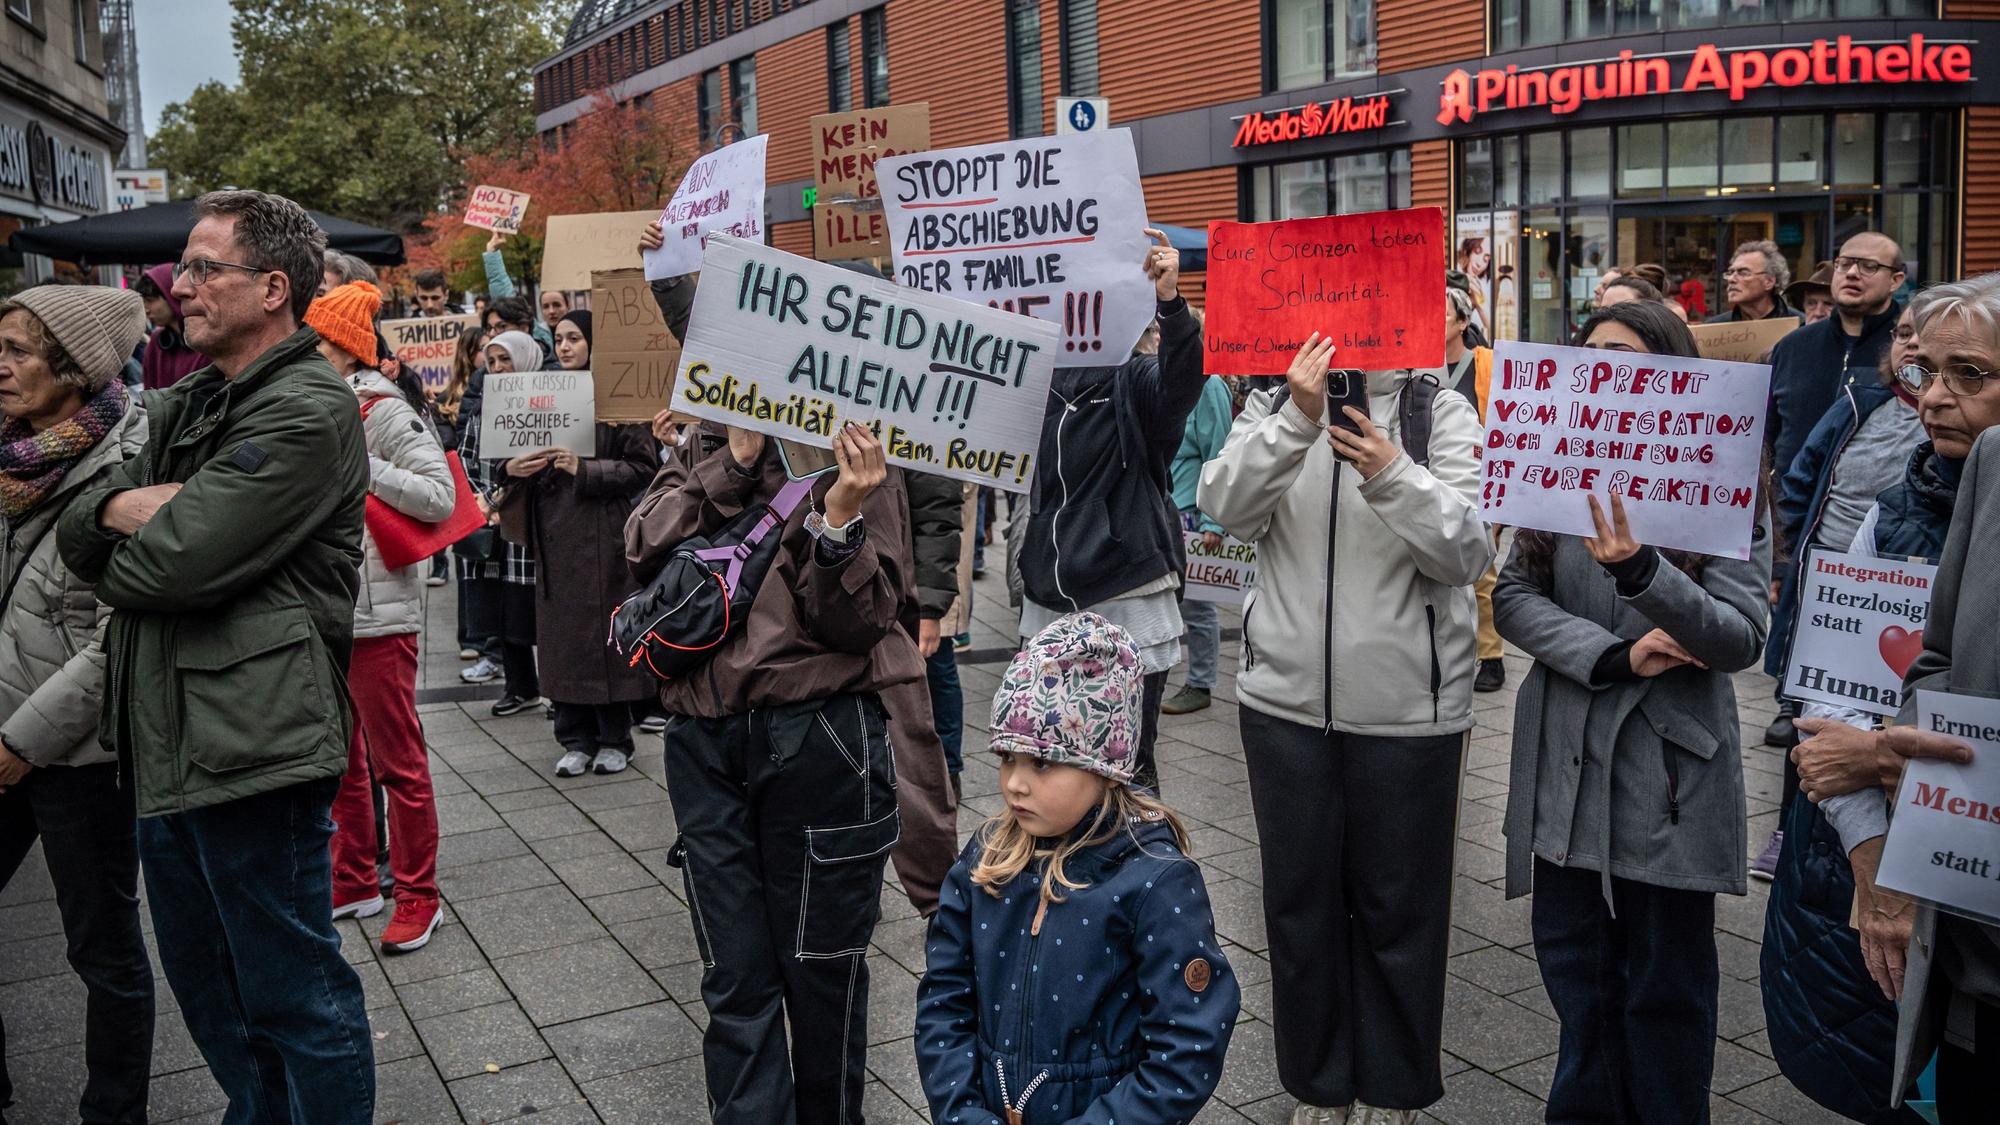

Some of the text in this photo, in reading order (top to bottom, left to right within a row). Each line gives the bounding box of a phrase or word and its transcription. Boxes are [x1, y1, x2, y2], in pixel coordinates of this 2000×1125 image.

[1477, 50, 1670, 114] Pinguin
[1682, 33, 1972, 100] Apotheke
[1233, 95, 1389, 148] Media Markt
[896, 148, 1062, 202] STOPPT DIE
[475, 190, 519, 206] HOLT
[661, 189, 730, 224] MENSCH
[682, 222, 699, 239] IST
[903, 198, 1099, 251] ABSCHIEBUNG
[1211, 225, 1428, 262] Eure Grenzen töten
[901, 253, 1066, 293] DER FAMILIE
[1257, 269, 1390, 311] Solidarität.
[737, 259, 1040, 388] IHR SEID NICHT
[396, 342, 454, 362] GEHÖRE
[1208, 335, 1249, 353] Unser
[1344, 333, 1382, 348] bleibt
[532, 374, 577, 391] KLASSEN
[787, 344, 928, 413] ALLEIN
[1502, 358, 1709, 394] IHR SPRECHT
[528, 395, 556, 409] KEINE
[685, 362, 836, 437] Solidarität
[889, 425, 939, 464] Fam.
[1495, 399, 1557, 425] VON
[509, 430, 553, 447] ZONEN
[1487, 429, 1714, 465] DOCH ABSCHIEBUNG
[1488, 460, 1753, 508] IST EURE REAKTION
[1815, 557, 1929, 589] Integration
[1811, 611, 1863, 635] statt
[1795, 664, 1905, 708] Huma
[1931, 849, 1991, 879] statt
